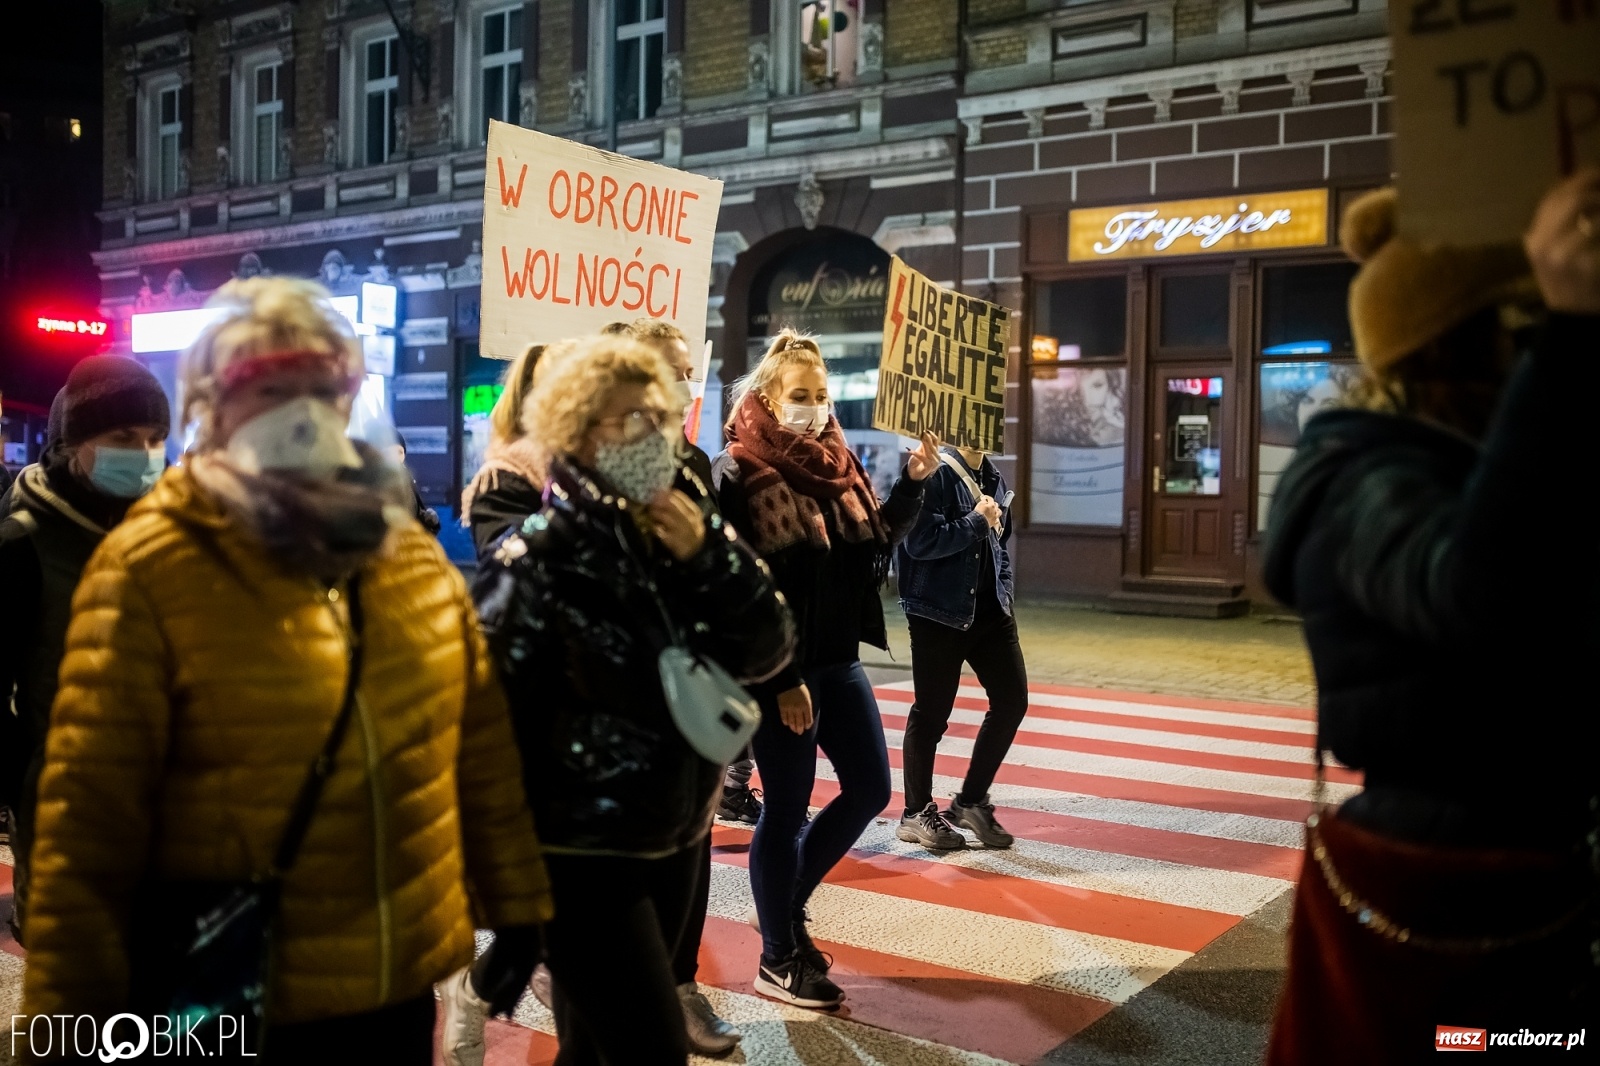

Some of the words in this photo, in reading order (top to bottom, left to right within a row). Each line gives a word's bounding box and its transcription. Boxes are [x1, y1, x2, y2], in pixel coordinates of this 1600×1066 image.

[1437, 50, 1547, 128] TO
[497, 156, 528, 208] W
[548, 169, 700, 244] OBRONIE
[1093, 202, 1291, 254] Fryzjer
[501, 245, 682, 320] WOLNOŚCI
[77, 320, 107, 335] 9-17
[877, 368, 1004, 451] WYPIERDALAJTE
